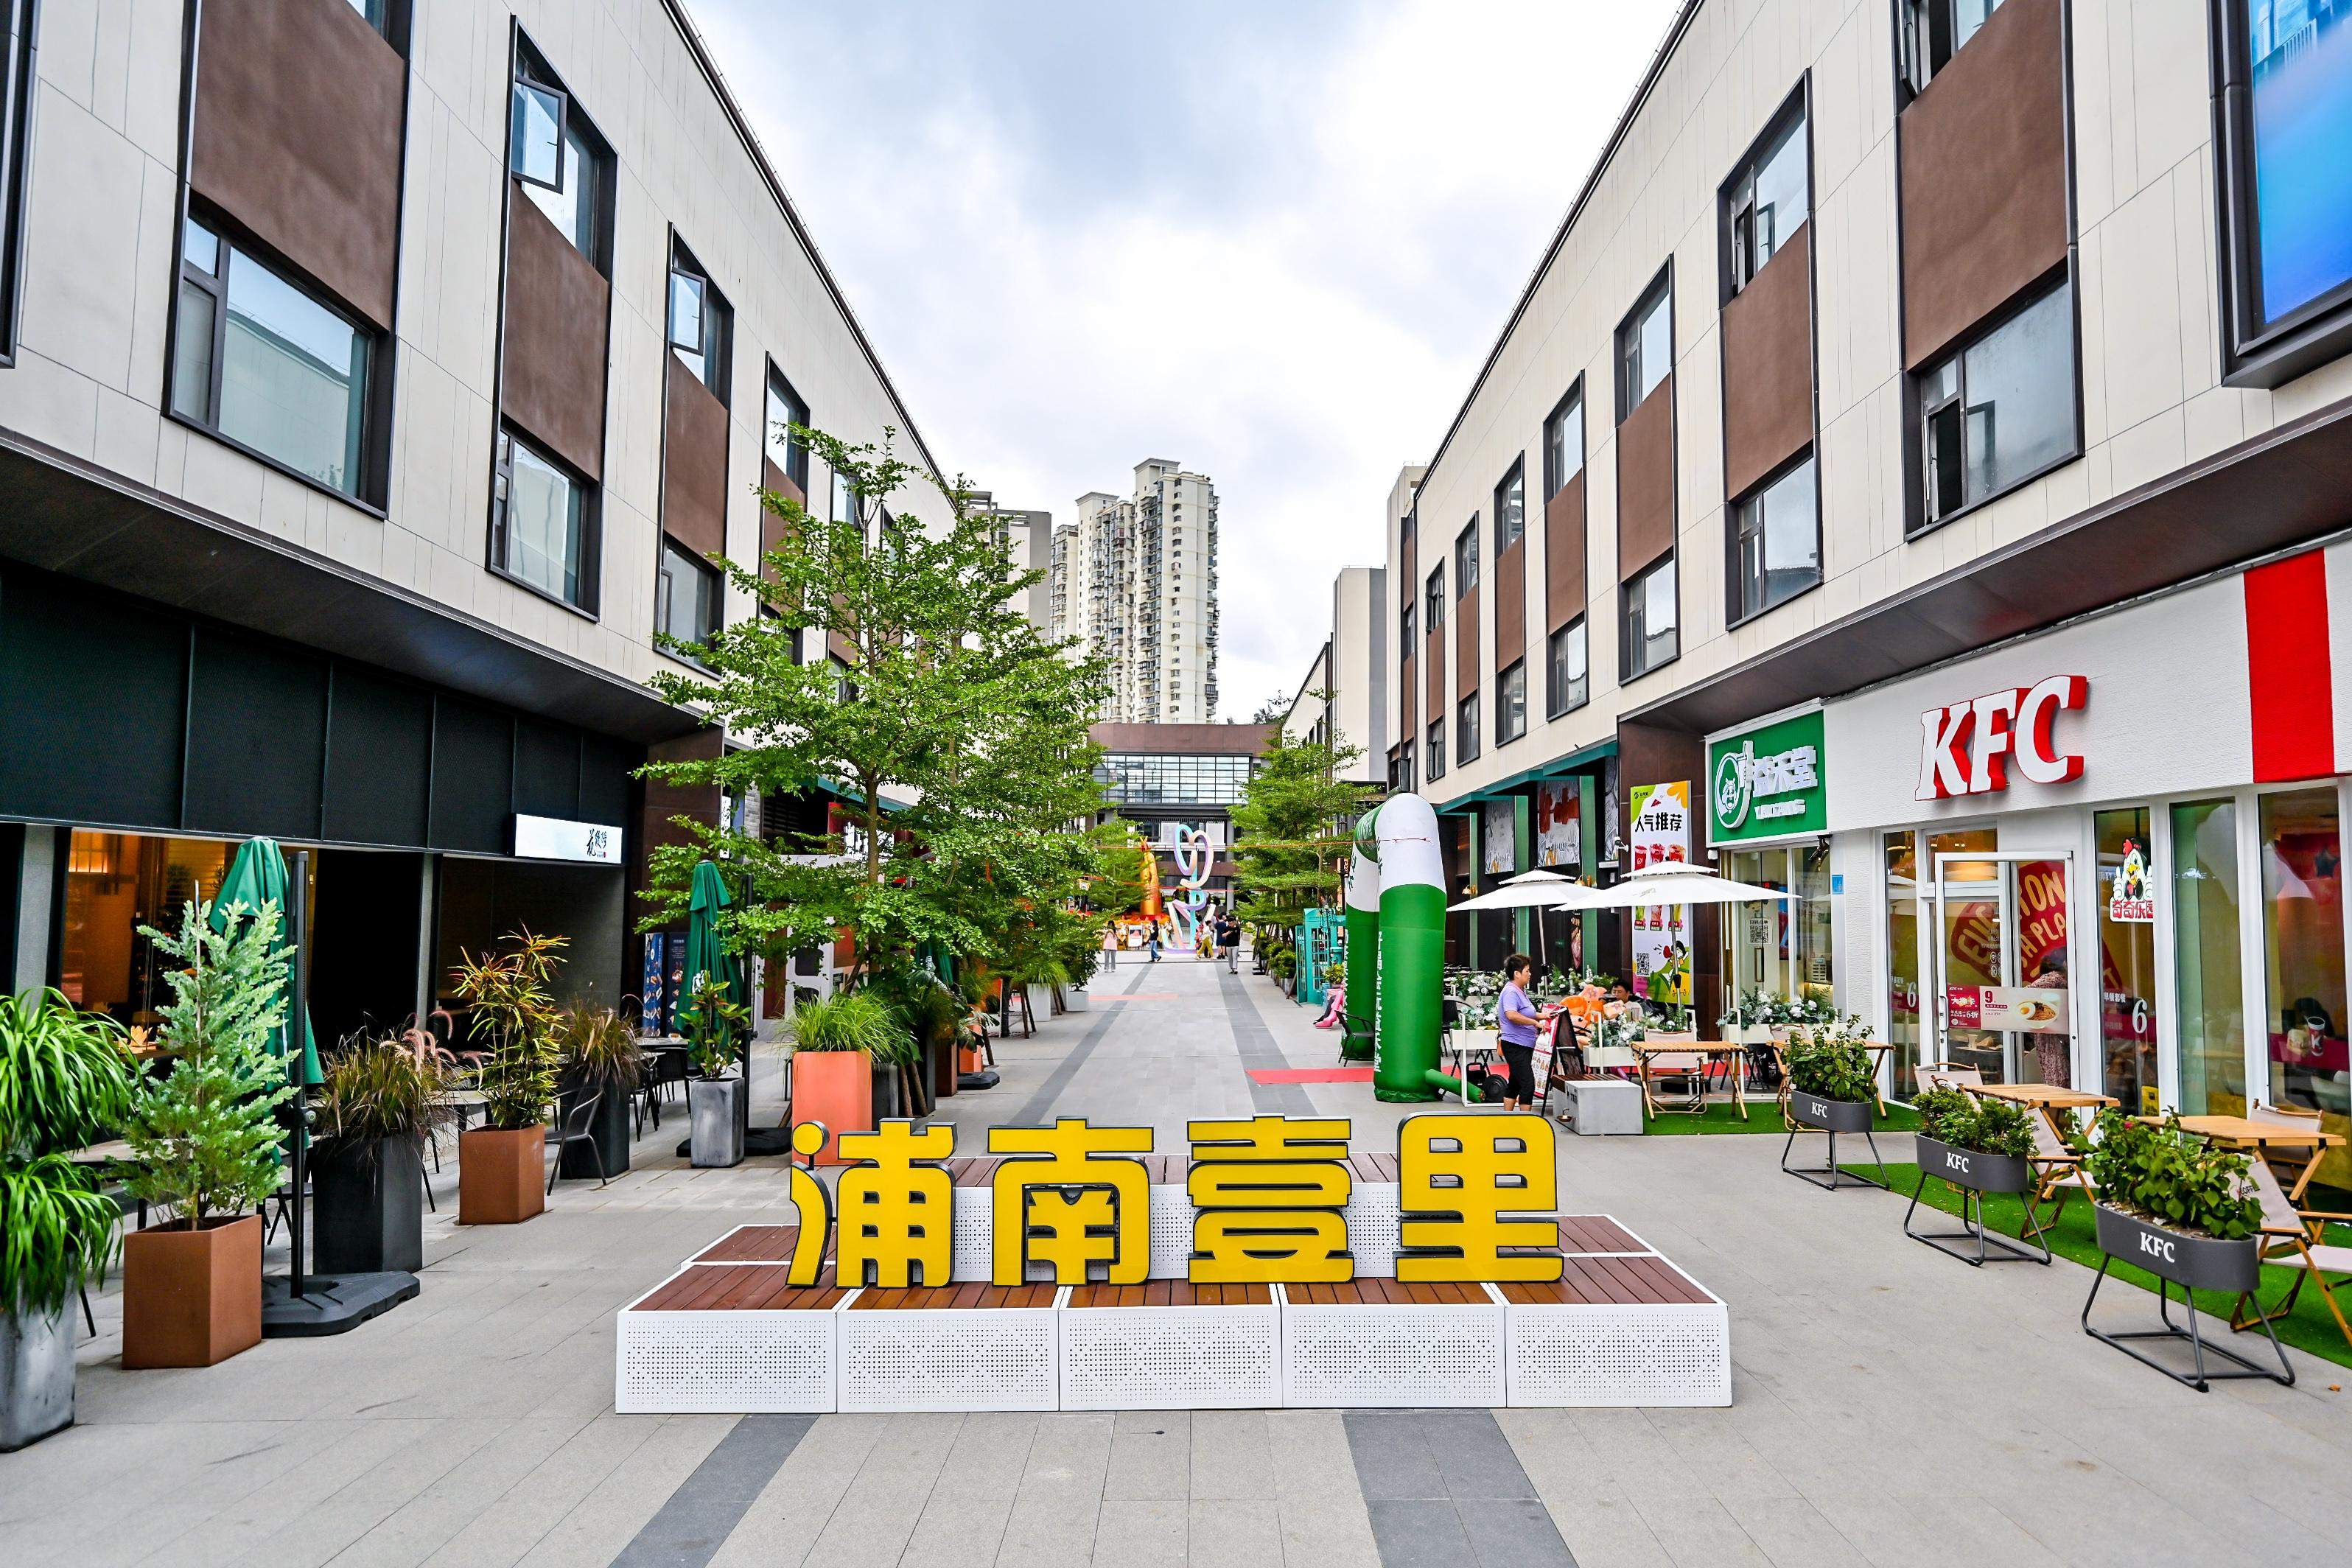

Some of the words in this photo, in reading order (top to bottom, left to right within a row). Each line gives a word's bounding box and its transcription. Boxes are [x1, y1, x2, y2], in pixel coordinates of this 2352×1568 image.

[1915, 675, 2086, 801] KFC
[1635, 812, 1682, 833] 人气推荐
[2112, 900, 2153, 919] 奇奇乐园
[1984, 990, 1993, 1003] 9
[2132, 997, 2147, 1034] 6
[1811, 1102, 1827, 1118] KFC
[1946, 1152, 1970, 1173] KFC
[2140, 1231, 2175, 1263] KFC
